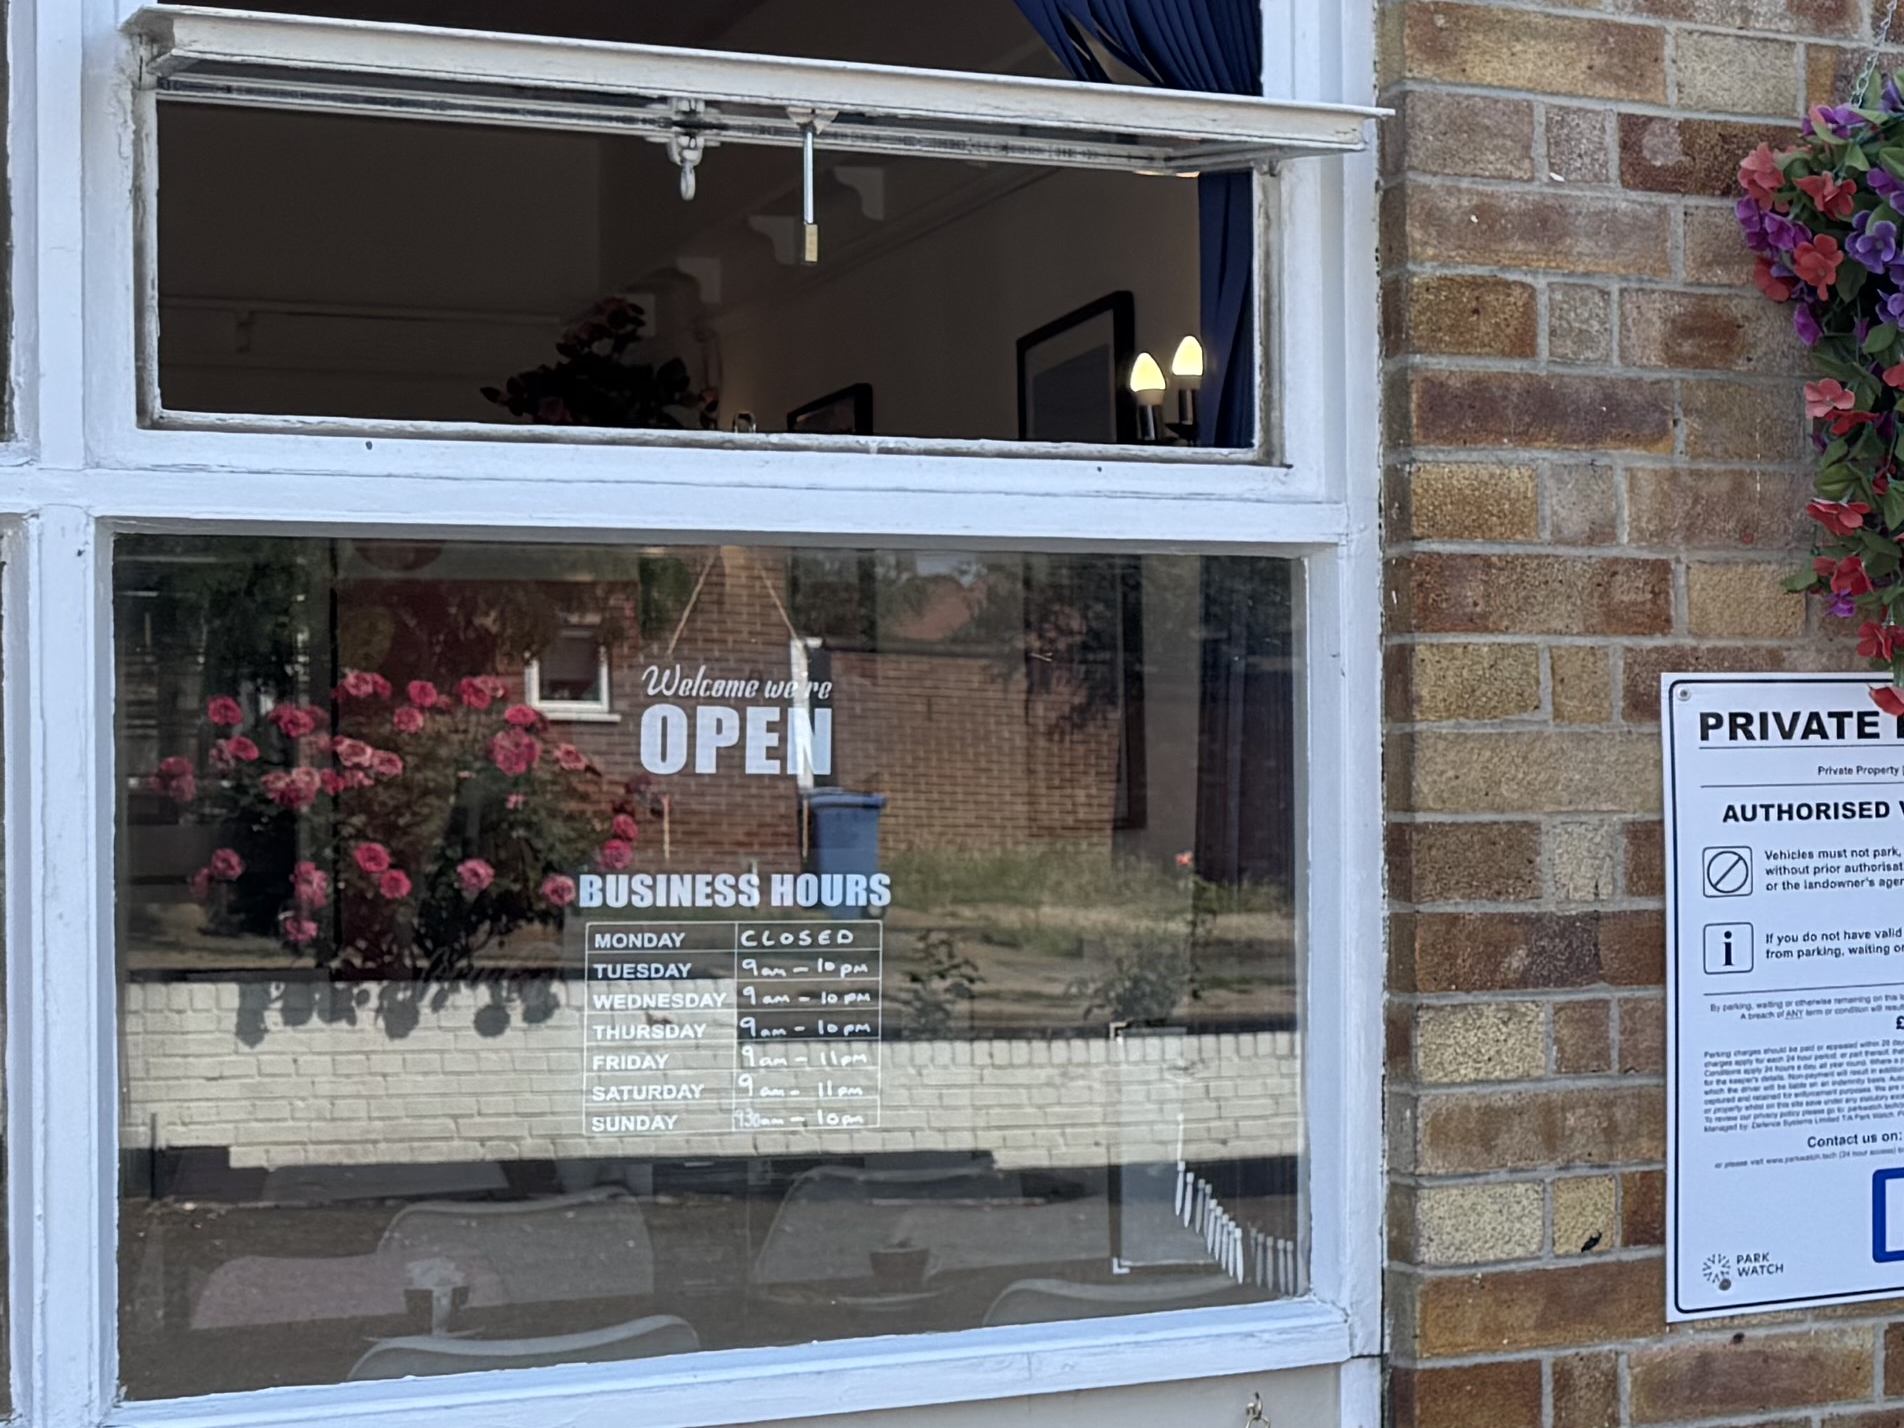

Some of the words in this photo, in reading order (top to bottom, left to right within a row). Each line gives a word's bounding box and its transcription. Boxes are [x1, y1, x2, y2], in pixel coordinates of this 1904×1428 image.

[641, 663, 759, 698] Welcome
[1700, 711, 1881, 741] PRIVATE
[640, 703, 832, 775] OPEN
[1721, 800, 1890, 822] AUTHORISED
[1763, 849, 1814, 860] Vehicles
[1817, 848, 1848, 859] must
[1849, 847, 1870, 858] not
[1872, 845, 1902, 859] park,
[1764, 864, 1810, 875] without
[1812, 863, 1841, 876] prior
[579, 873, 760, 908] BUSINESS
[771, 873, 892, 908] HOURS
[1765, 882, 1778, 891] or
[1781, 879, 1800, 891] the
[594, 932, 685, 949] MONDAY
[740, 929, 854, 947] CLOSED
[1765, 932, 1774, 944] If
[1776, 934, 1799, 946] you
[1801, 931, 1818, 942] do
[1820, 930, 1840, 941] not
[1842, 929, 1872, 940] have
[1873, 926, 1902, 939] valid
[1765, 948, 1794, 959] from
[1796, 945, 1845, 959] parking,
[1847, 943, 1890, 956] waiting
[1892, 943, 1904, 953] or
[593, 962, 692, 979] TUESDAY
[593, 992, 727, 1009] WEDNESDAY
[591, 1023, 706, 1040] THURSDAY
[592, 1054, 670, 1071] FRIDAY
[592, 1084, 705, 1102] SATURDAY
[591, 1114, 679, 1132] SUNDAY
[1806, 1133, 1858, 1148] Contact
[1861, 1133, 1877, 1144] us
[1735, 1251, 1770, 1264] PARK
[1736, 1263, 1784, 1277] WATCH
